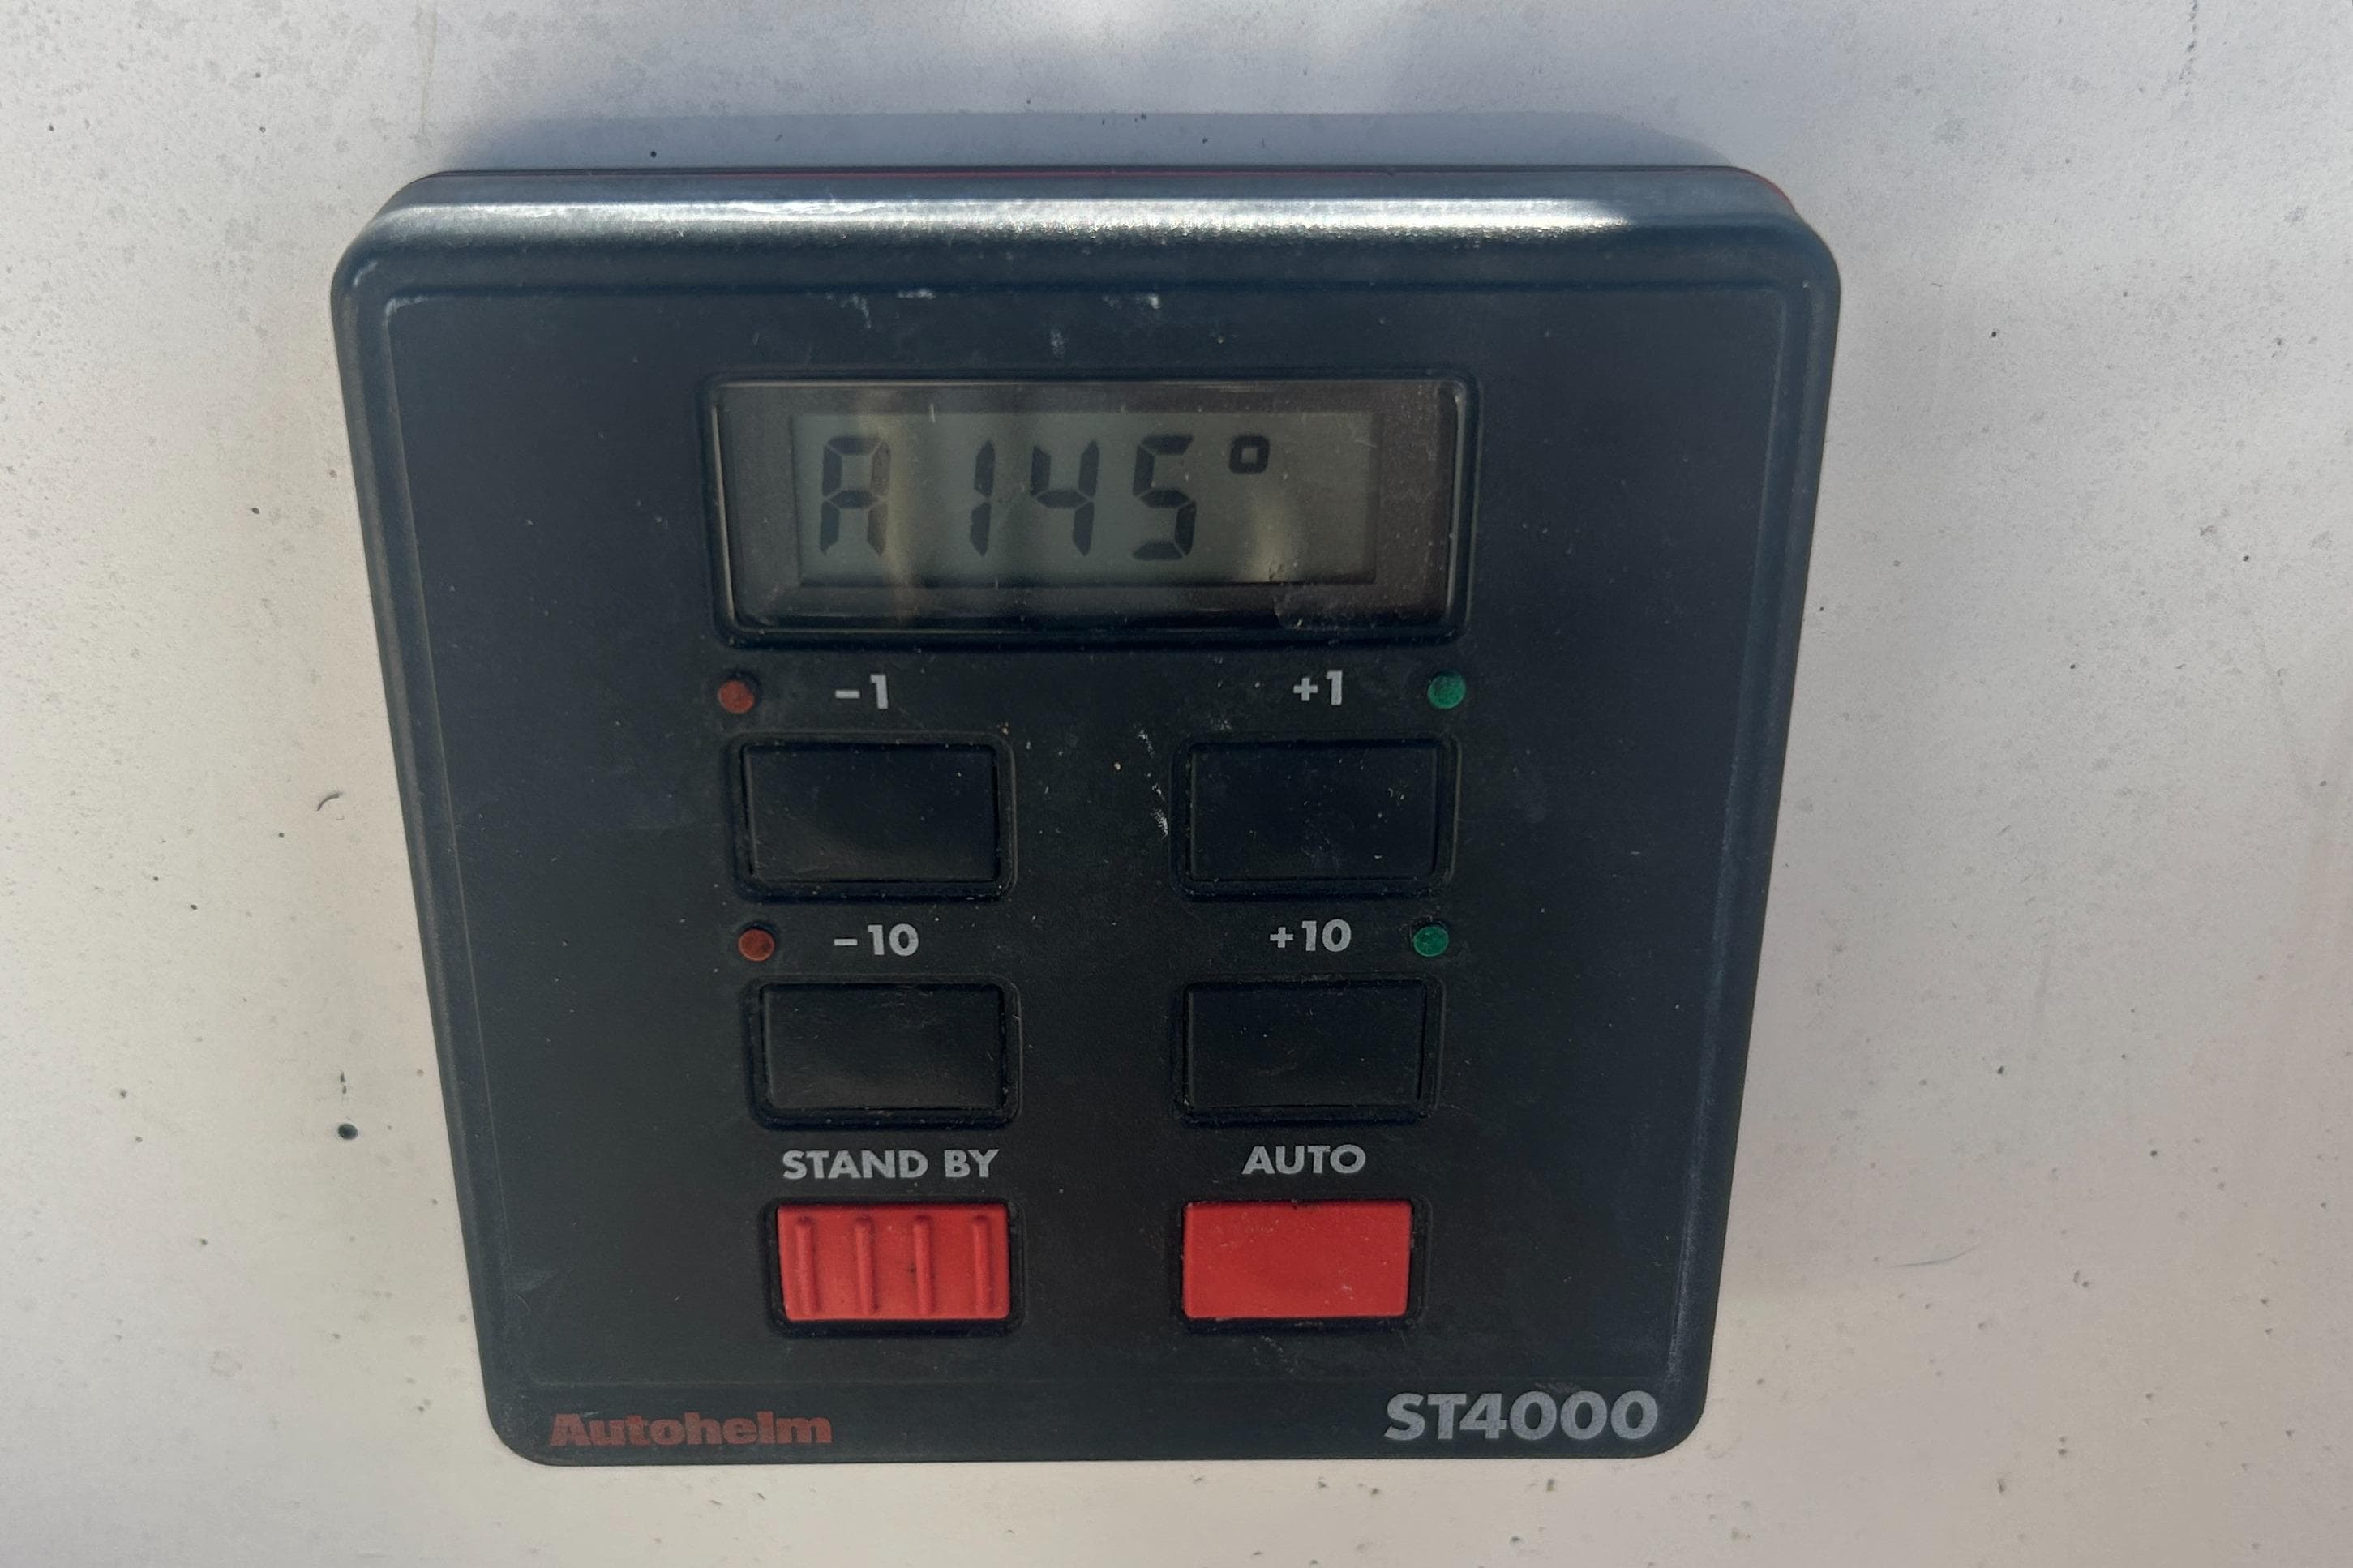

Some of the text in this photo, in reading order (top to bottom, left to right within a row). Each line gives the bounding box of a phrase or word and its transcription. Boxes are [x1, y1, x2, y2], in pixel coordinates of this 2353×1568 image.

[1293, 670, 1343, 705] +1
[1270, 919, 1352, 953] +10
[782, 1148, 1000, 1180] STAND BY
[1241, 1144, 1366, 1175] AUTO
[549, 1411, 833, 1446] Autohelm
[1383, 1390, 1659, 1441] ST4000
